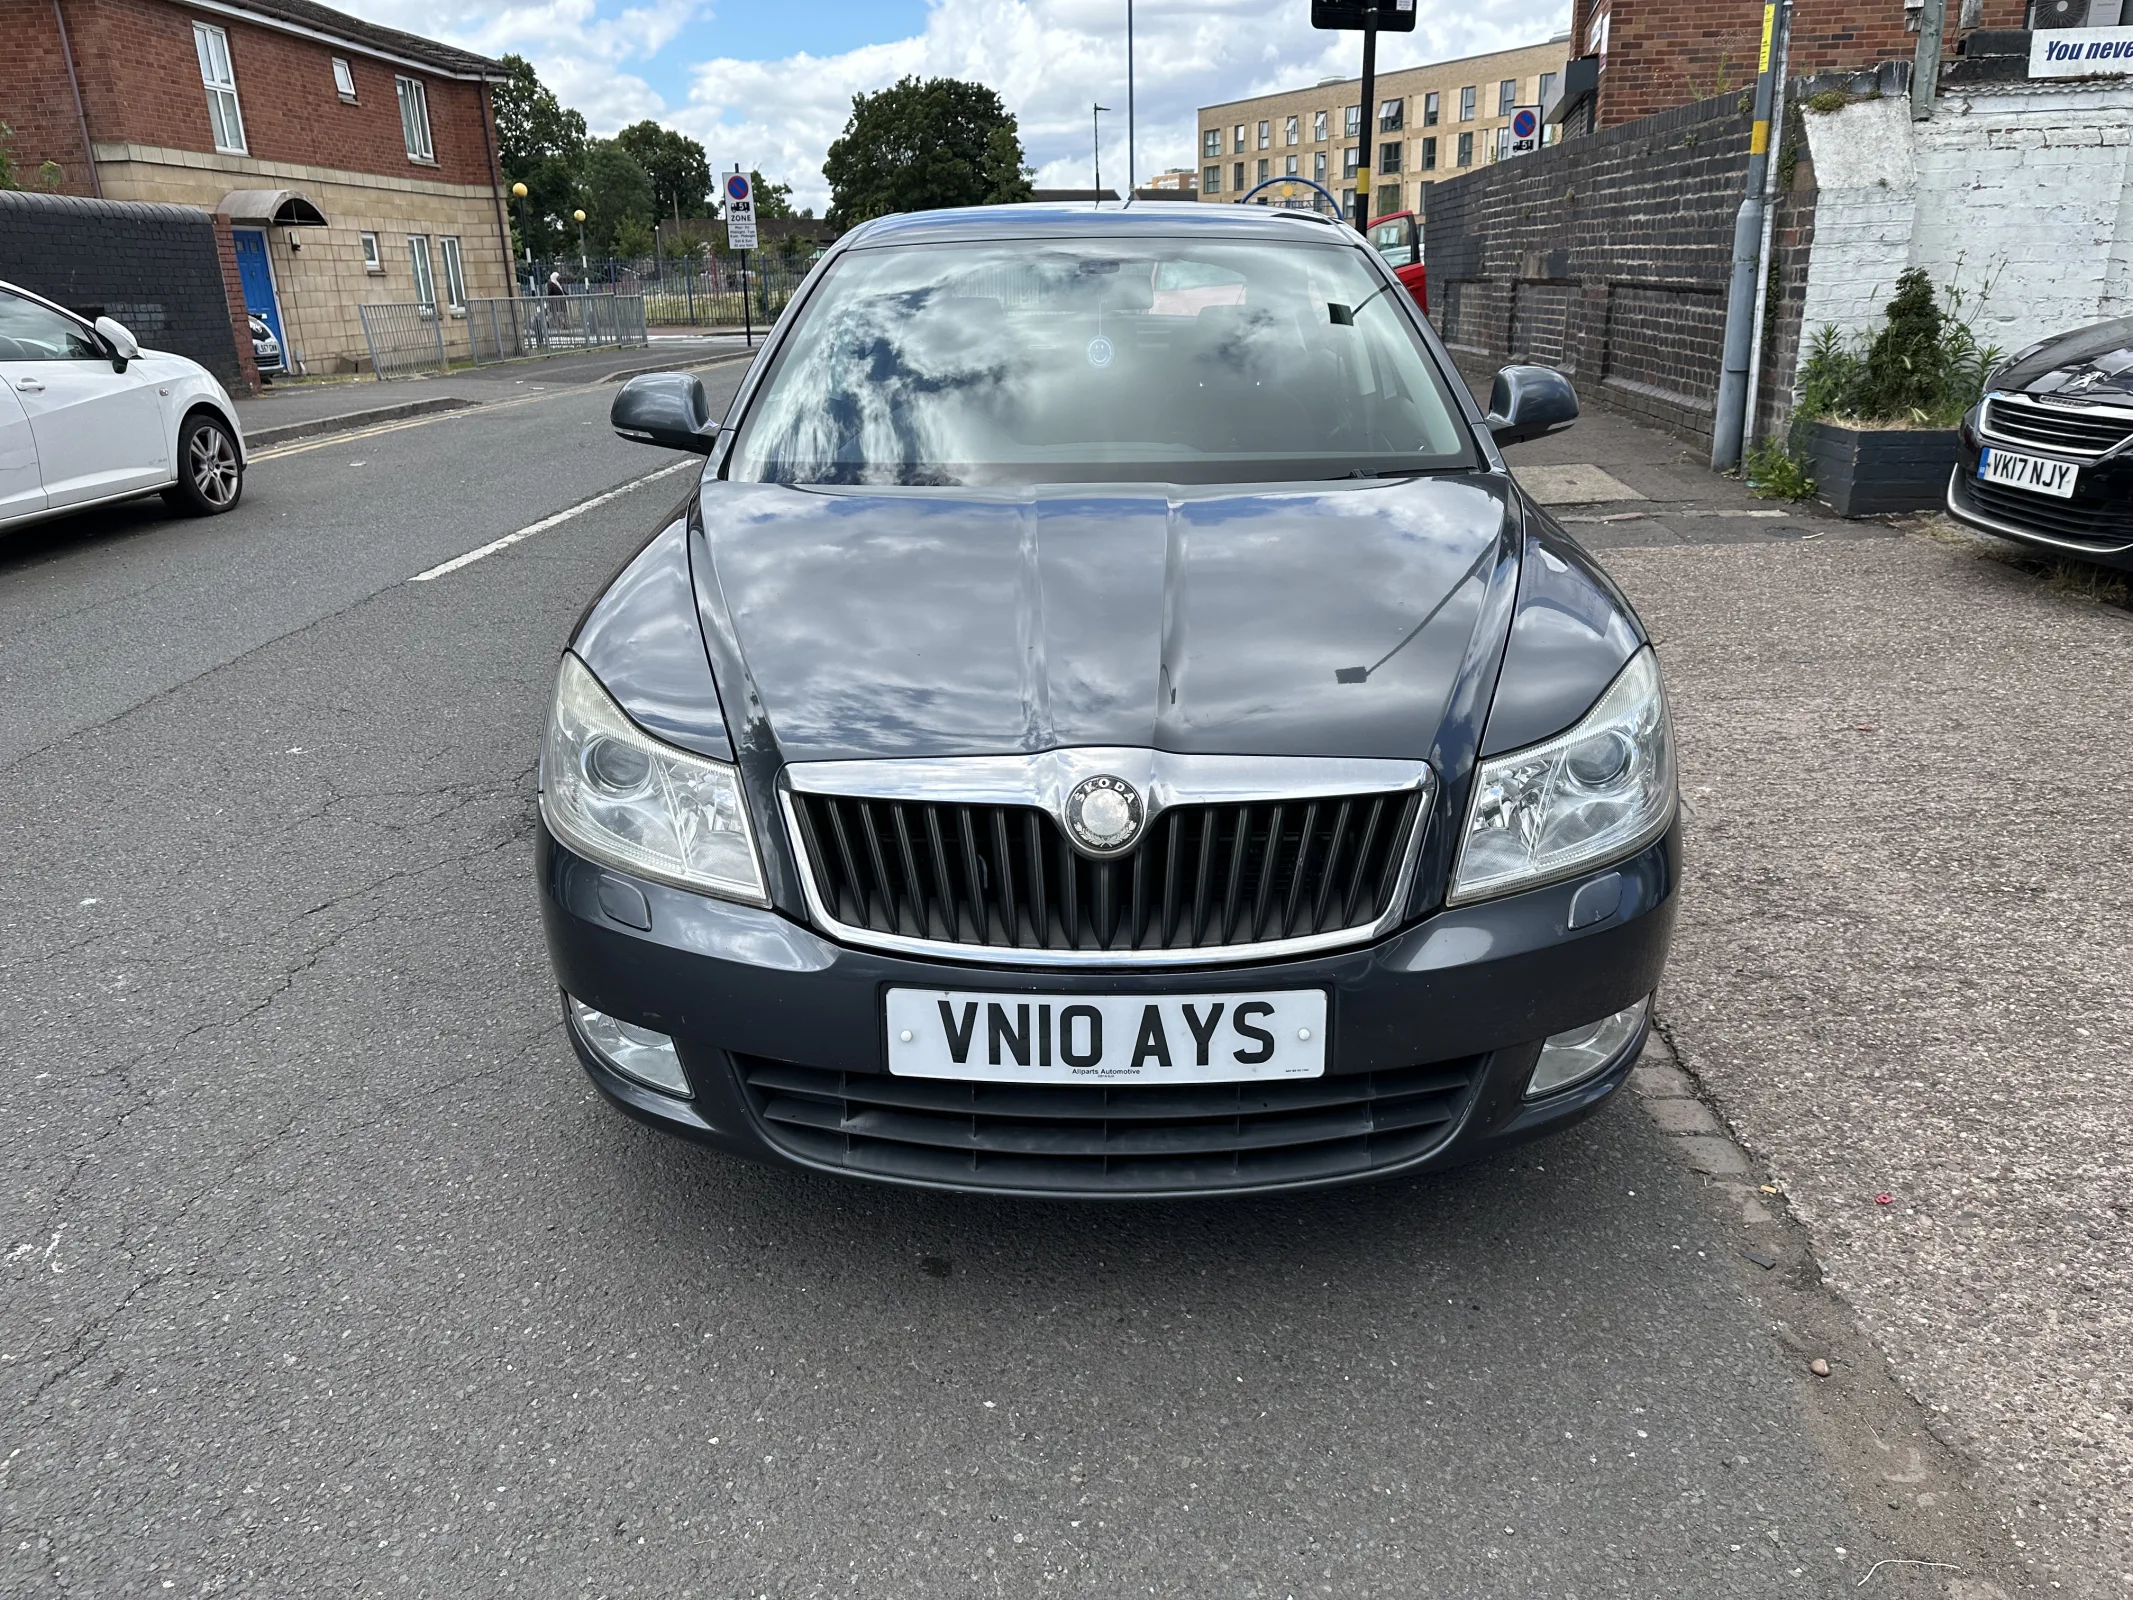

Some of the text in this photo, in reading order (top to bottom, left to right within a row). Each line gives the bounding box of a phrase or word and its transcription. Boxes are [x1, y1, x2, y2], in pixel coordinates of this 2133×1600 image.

[2046, 40, 2084, 61] You
[1993, 453, 2070, 490] VK17 NJY
[937, 1000, 1276, 1067] VN10 AYS
[1072, 1068, 1099, 1076] Allparts
